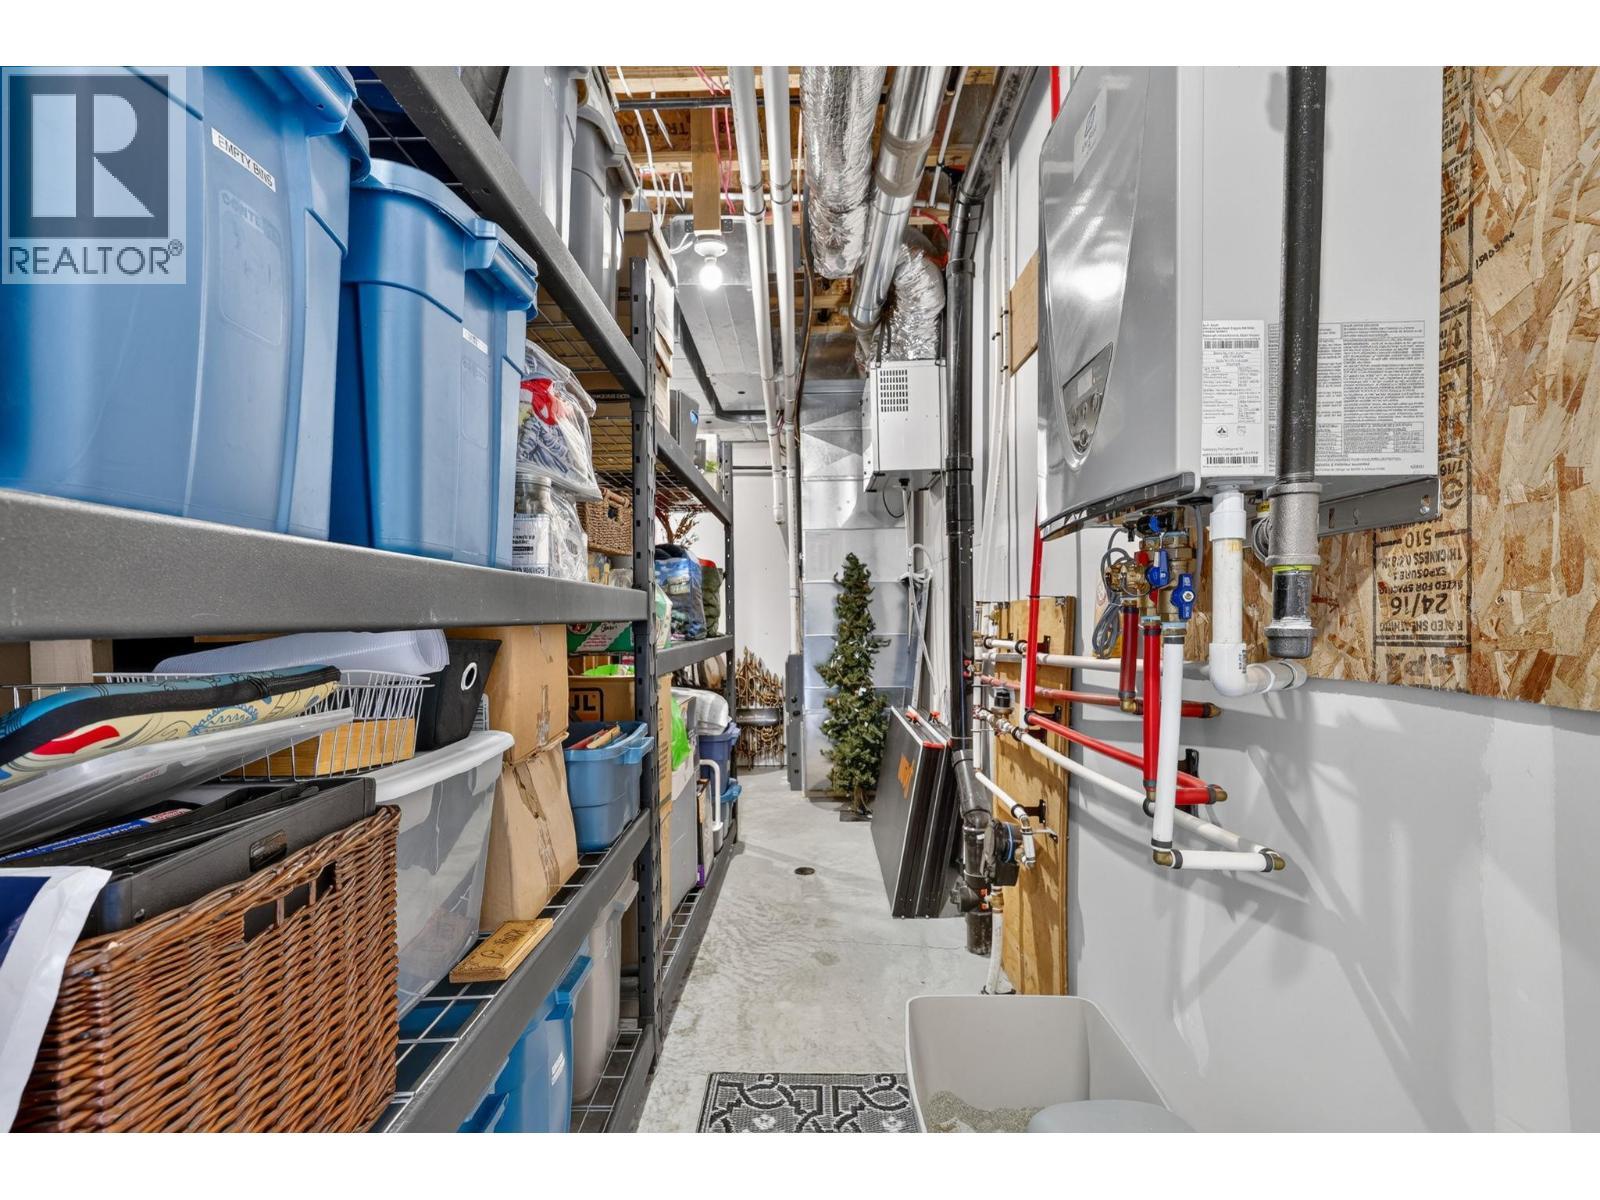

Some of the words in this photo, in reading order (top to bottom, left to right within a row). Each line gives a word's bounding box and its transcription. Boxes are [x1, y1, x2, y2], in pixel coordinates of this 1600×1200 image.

[217, 134, 252, 170] EMPTY
[252, 162, 275, 188] BINS
[1404, 528, 1432, 548] 510
[1398, 566, 1447, 580] EXPOSURE
[1415, 582, 1433, 593] FOR
[1390, 592, 1449, 617] 24/16
